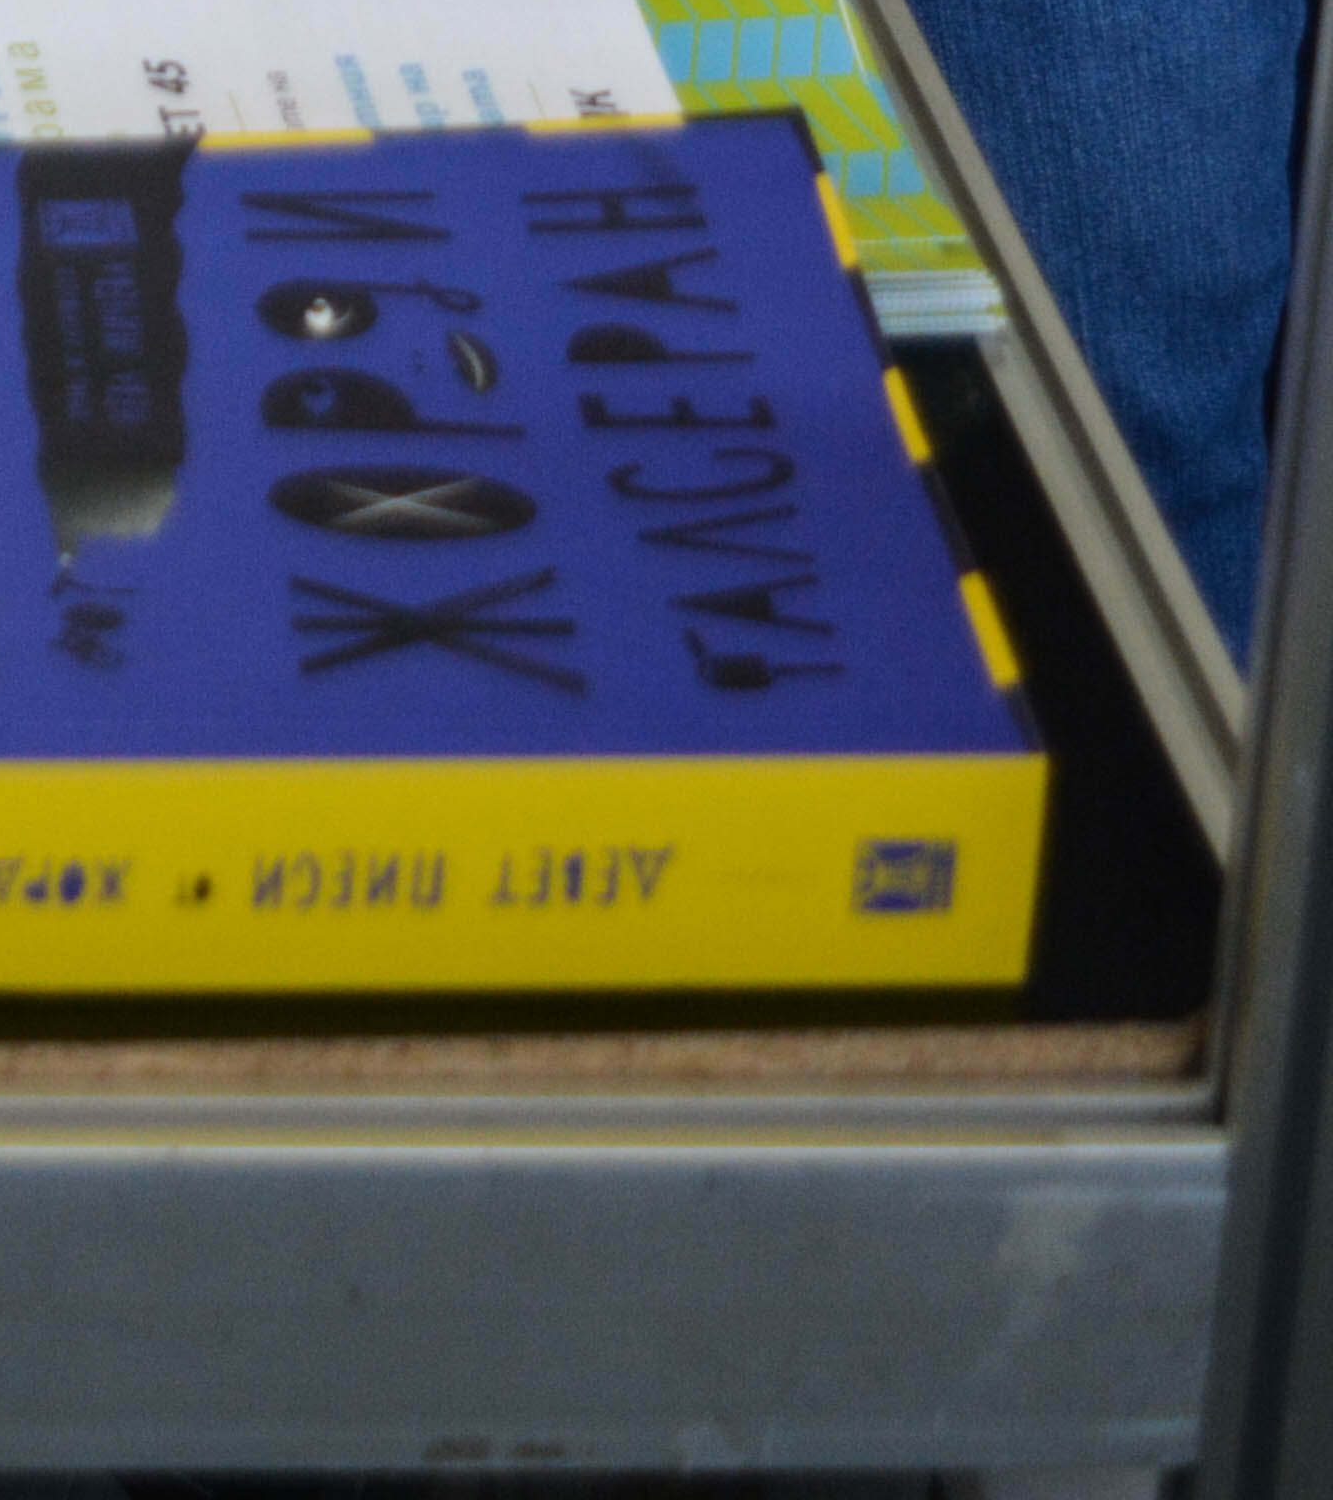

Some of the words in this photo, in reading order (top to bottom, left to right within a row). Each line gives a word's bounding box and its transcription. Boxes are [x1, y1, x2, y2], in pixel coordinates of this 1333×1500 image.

[143, 58, 190, 96] 45
[520, 182, 847, 692] ГАЛСЕРАН
[250, 849, 446, 911] ПИЕСИ
[489, 843, 676, 911] ДЕВЕТ
